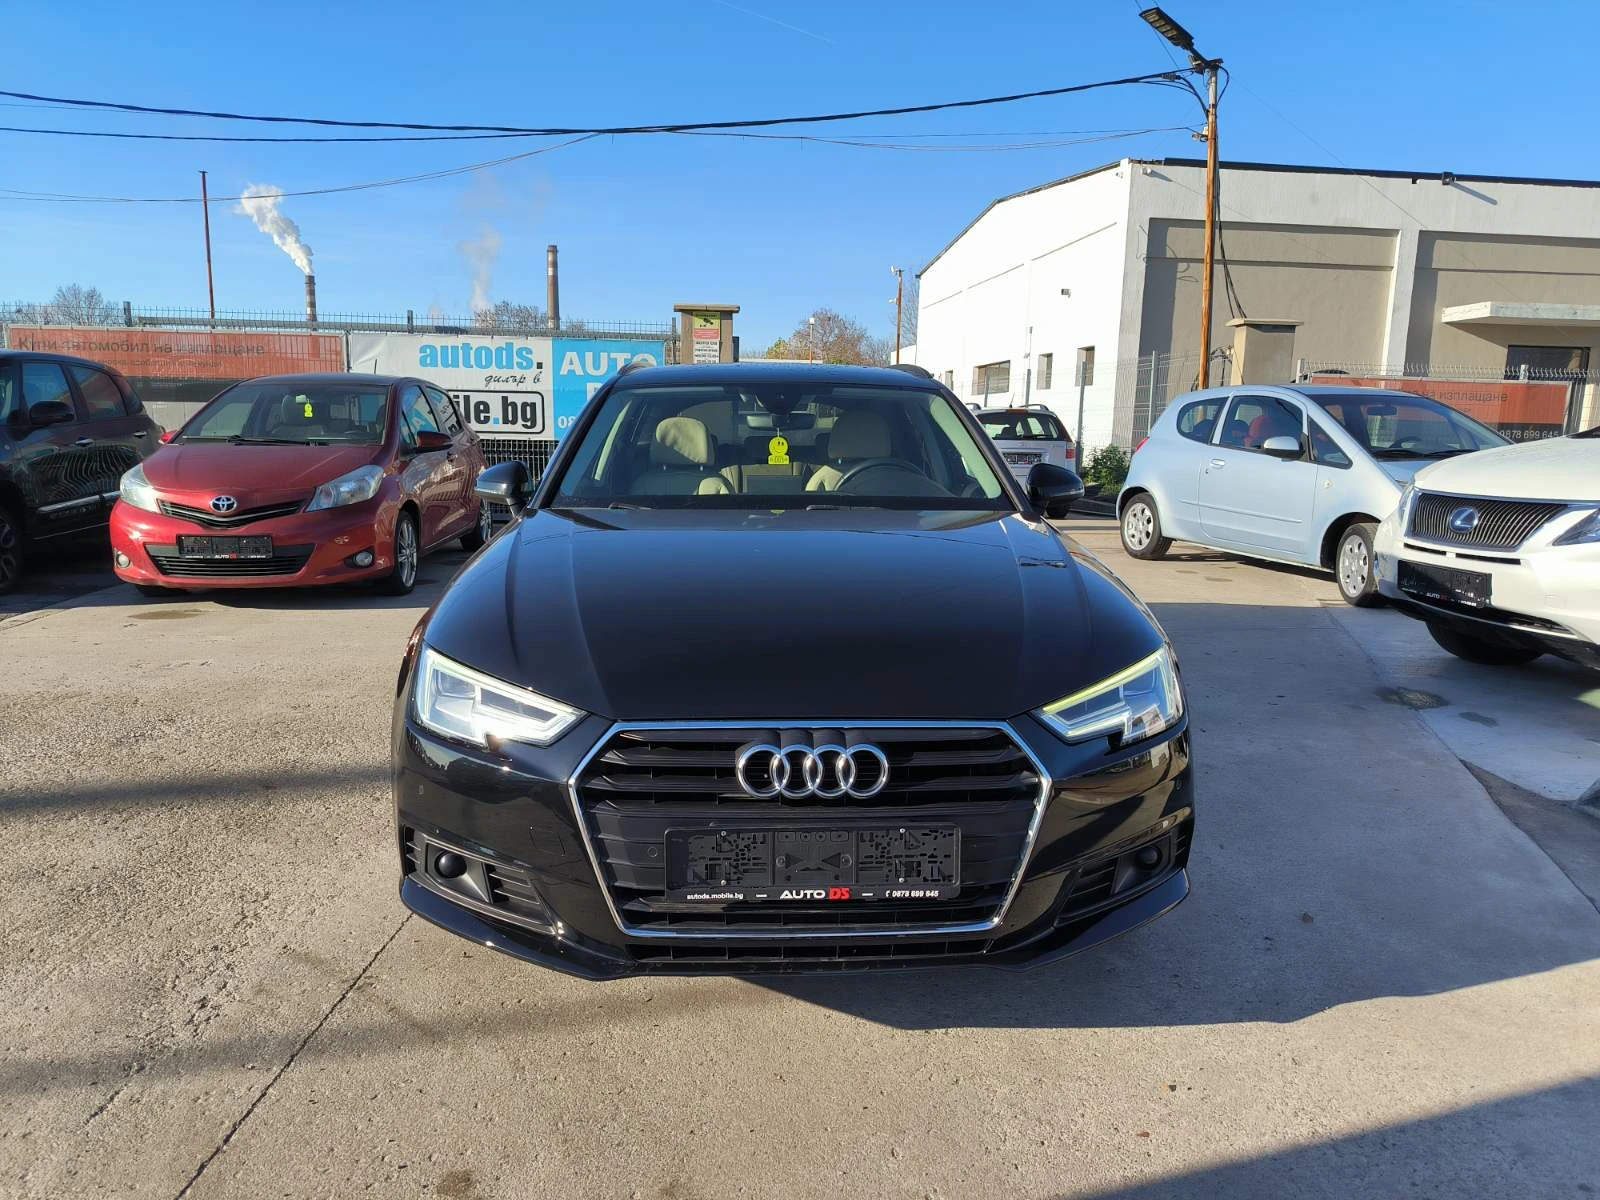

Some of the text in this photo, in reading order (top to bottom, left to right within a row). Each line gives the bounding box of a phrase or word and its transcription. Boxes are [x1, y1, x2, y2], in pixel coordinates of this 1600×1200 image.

[453, 394, 537, 429] ile.bg
[780, 889, 826, 899] AUTO
[828, 888, 850, 899] DS
